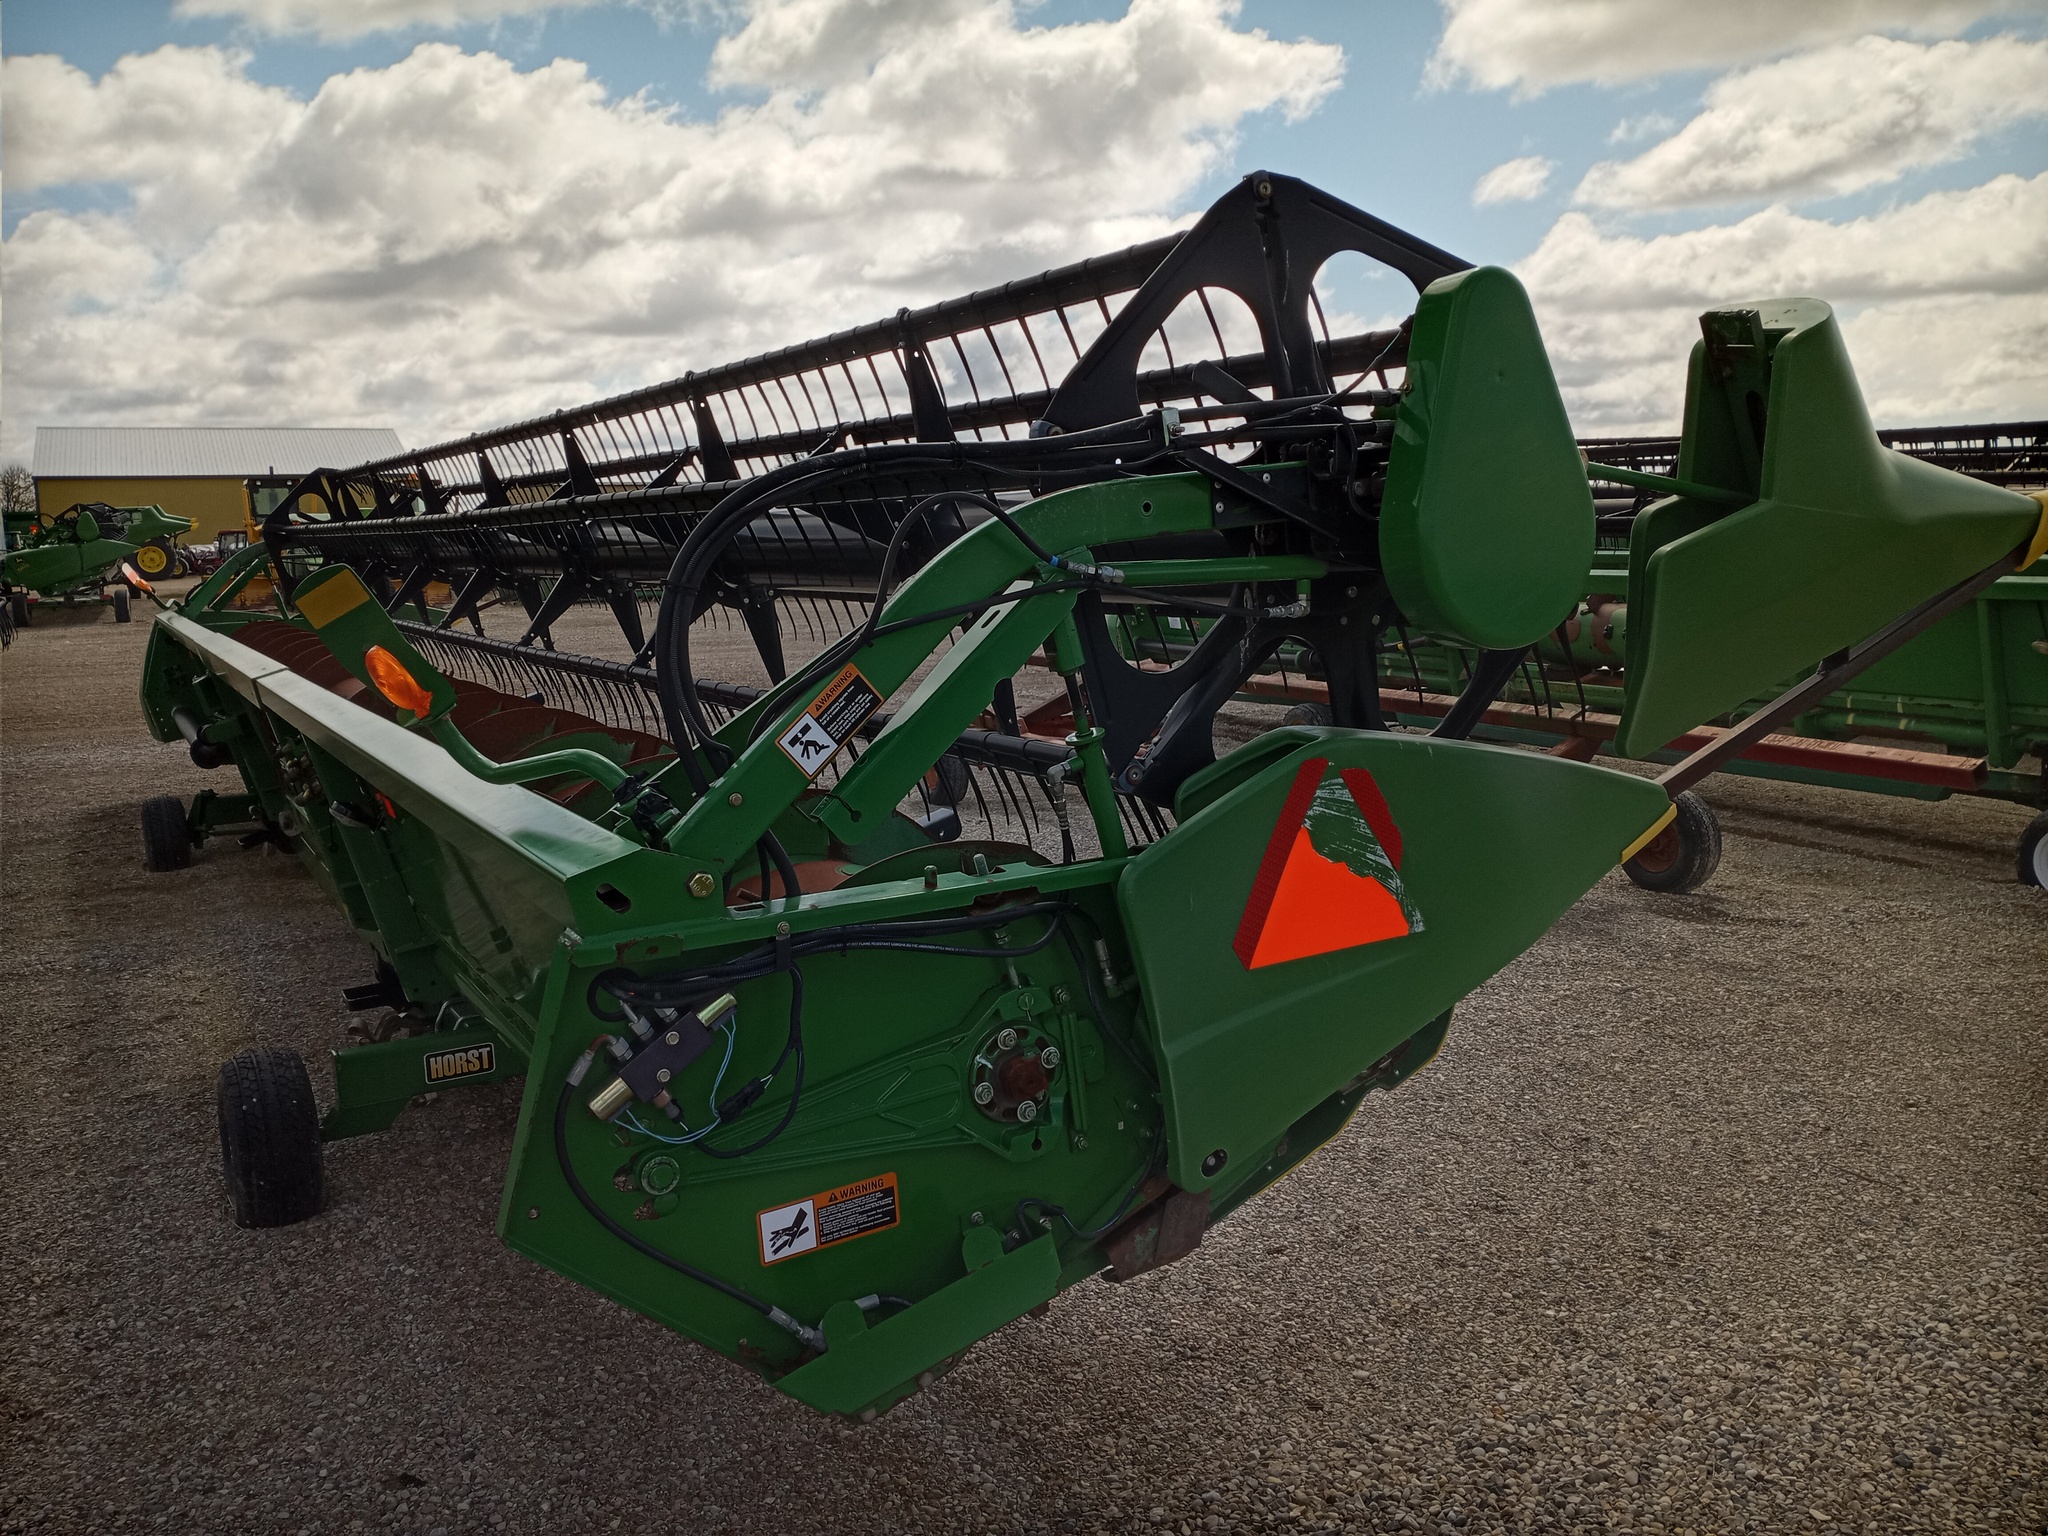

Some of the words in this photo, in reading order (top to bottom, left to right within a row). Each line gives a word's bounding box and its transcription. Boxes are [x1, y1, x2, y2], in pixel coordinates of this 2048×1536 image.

[819, 671, 853, 708] WARNING
[429, 1047, 491, 1079] HORST
[840, 1178, 884, 1199] WARNING
